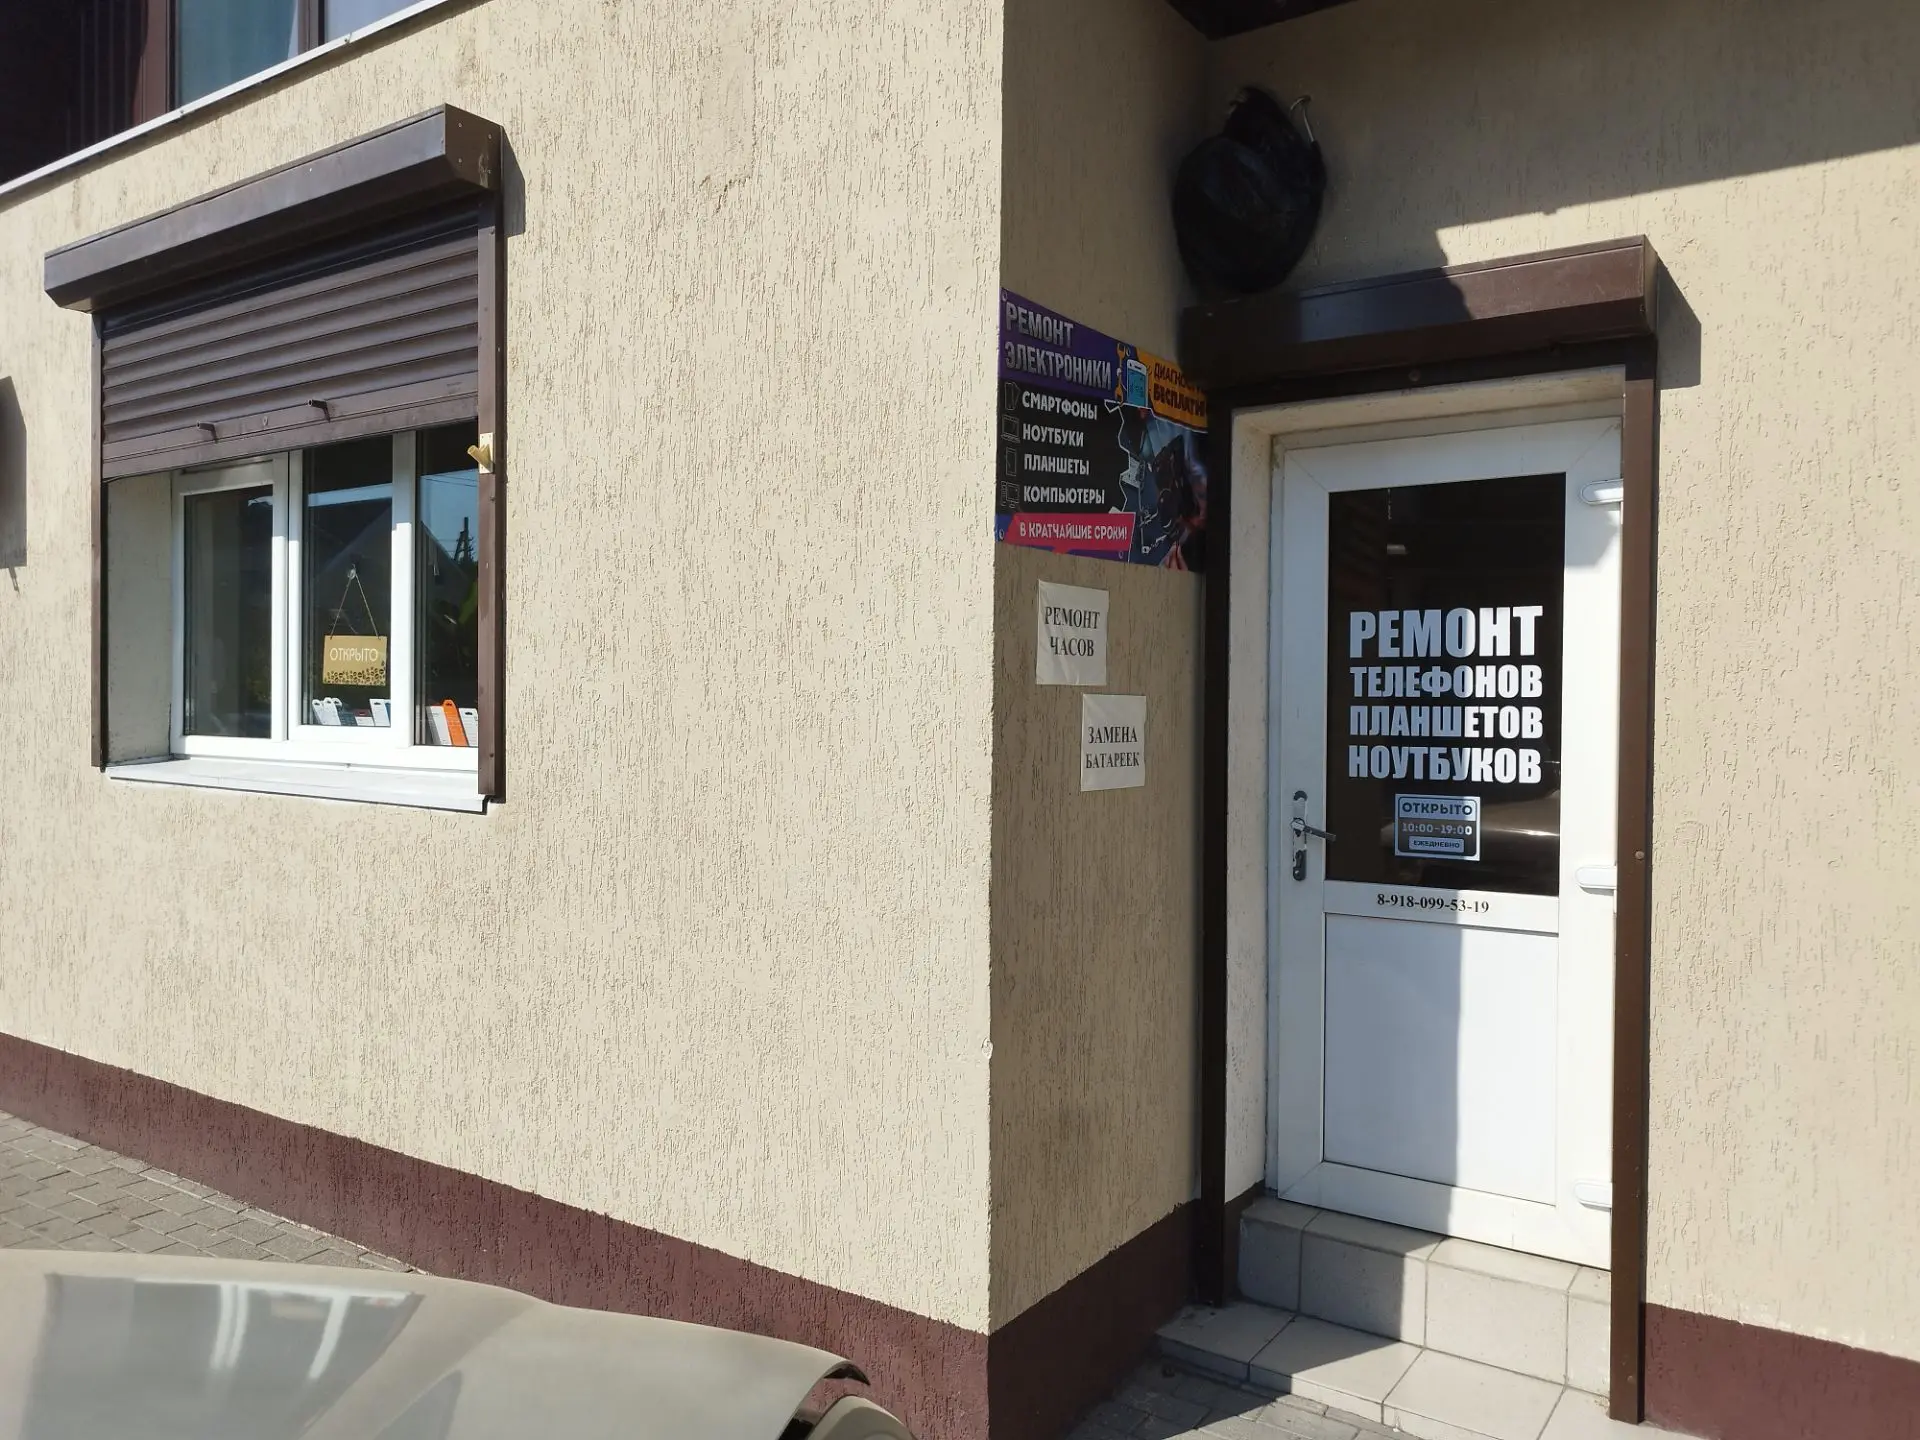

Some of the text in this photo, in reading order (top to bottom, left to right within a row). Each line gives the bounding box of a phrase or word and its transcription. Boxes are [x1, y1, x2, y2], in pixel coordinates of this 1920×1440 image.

[1005, 301, 1074, 348] РЕМОНТ
[1005, 341, 1112, 391] ЭЛЕКТРОНИКИ
[1022, 391, 1098, 420] СМАРТФОНЫ
[1022, 424, 1084, 447] НОУТБУКИ
[1023, 454, 1090, 476] ПЛАНШЕТЫ
[1023, 485, 1105, 504] КОМПЬЮТЕРЫ
[1019, 521, 1128, 541] В КРАТЧАЙШИЕ СРОКИ!
[1044, 606, 1100, 629] РЕМОНТ
[1349, 605, 1544, 658] РЕМОНТ
[329, 647, 379, 662] ОТКРЫТО
[1050, 636, 1094, 657] ЧАСОВ
[1349, 664, 1543, 698] ТЕЛЕФОНОВ
[1349, 705, 1543, 739] ПЛАНШЕТОВ
[1088, 726, 1138, 744] ЗАМЕНА
[1085, 751, 1140, 769] БАТАРЕЕК
[1348, 745, 1542, 784] НОУТБУКОВ
[1402, 802, 1473, 816] ОТКРЫТО
[1377, 893, 1489, 913] 8-918-099-53-19
